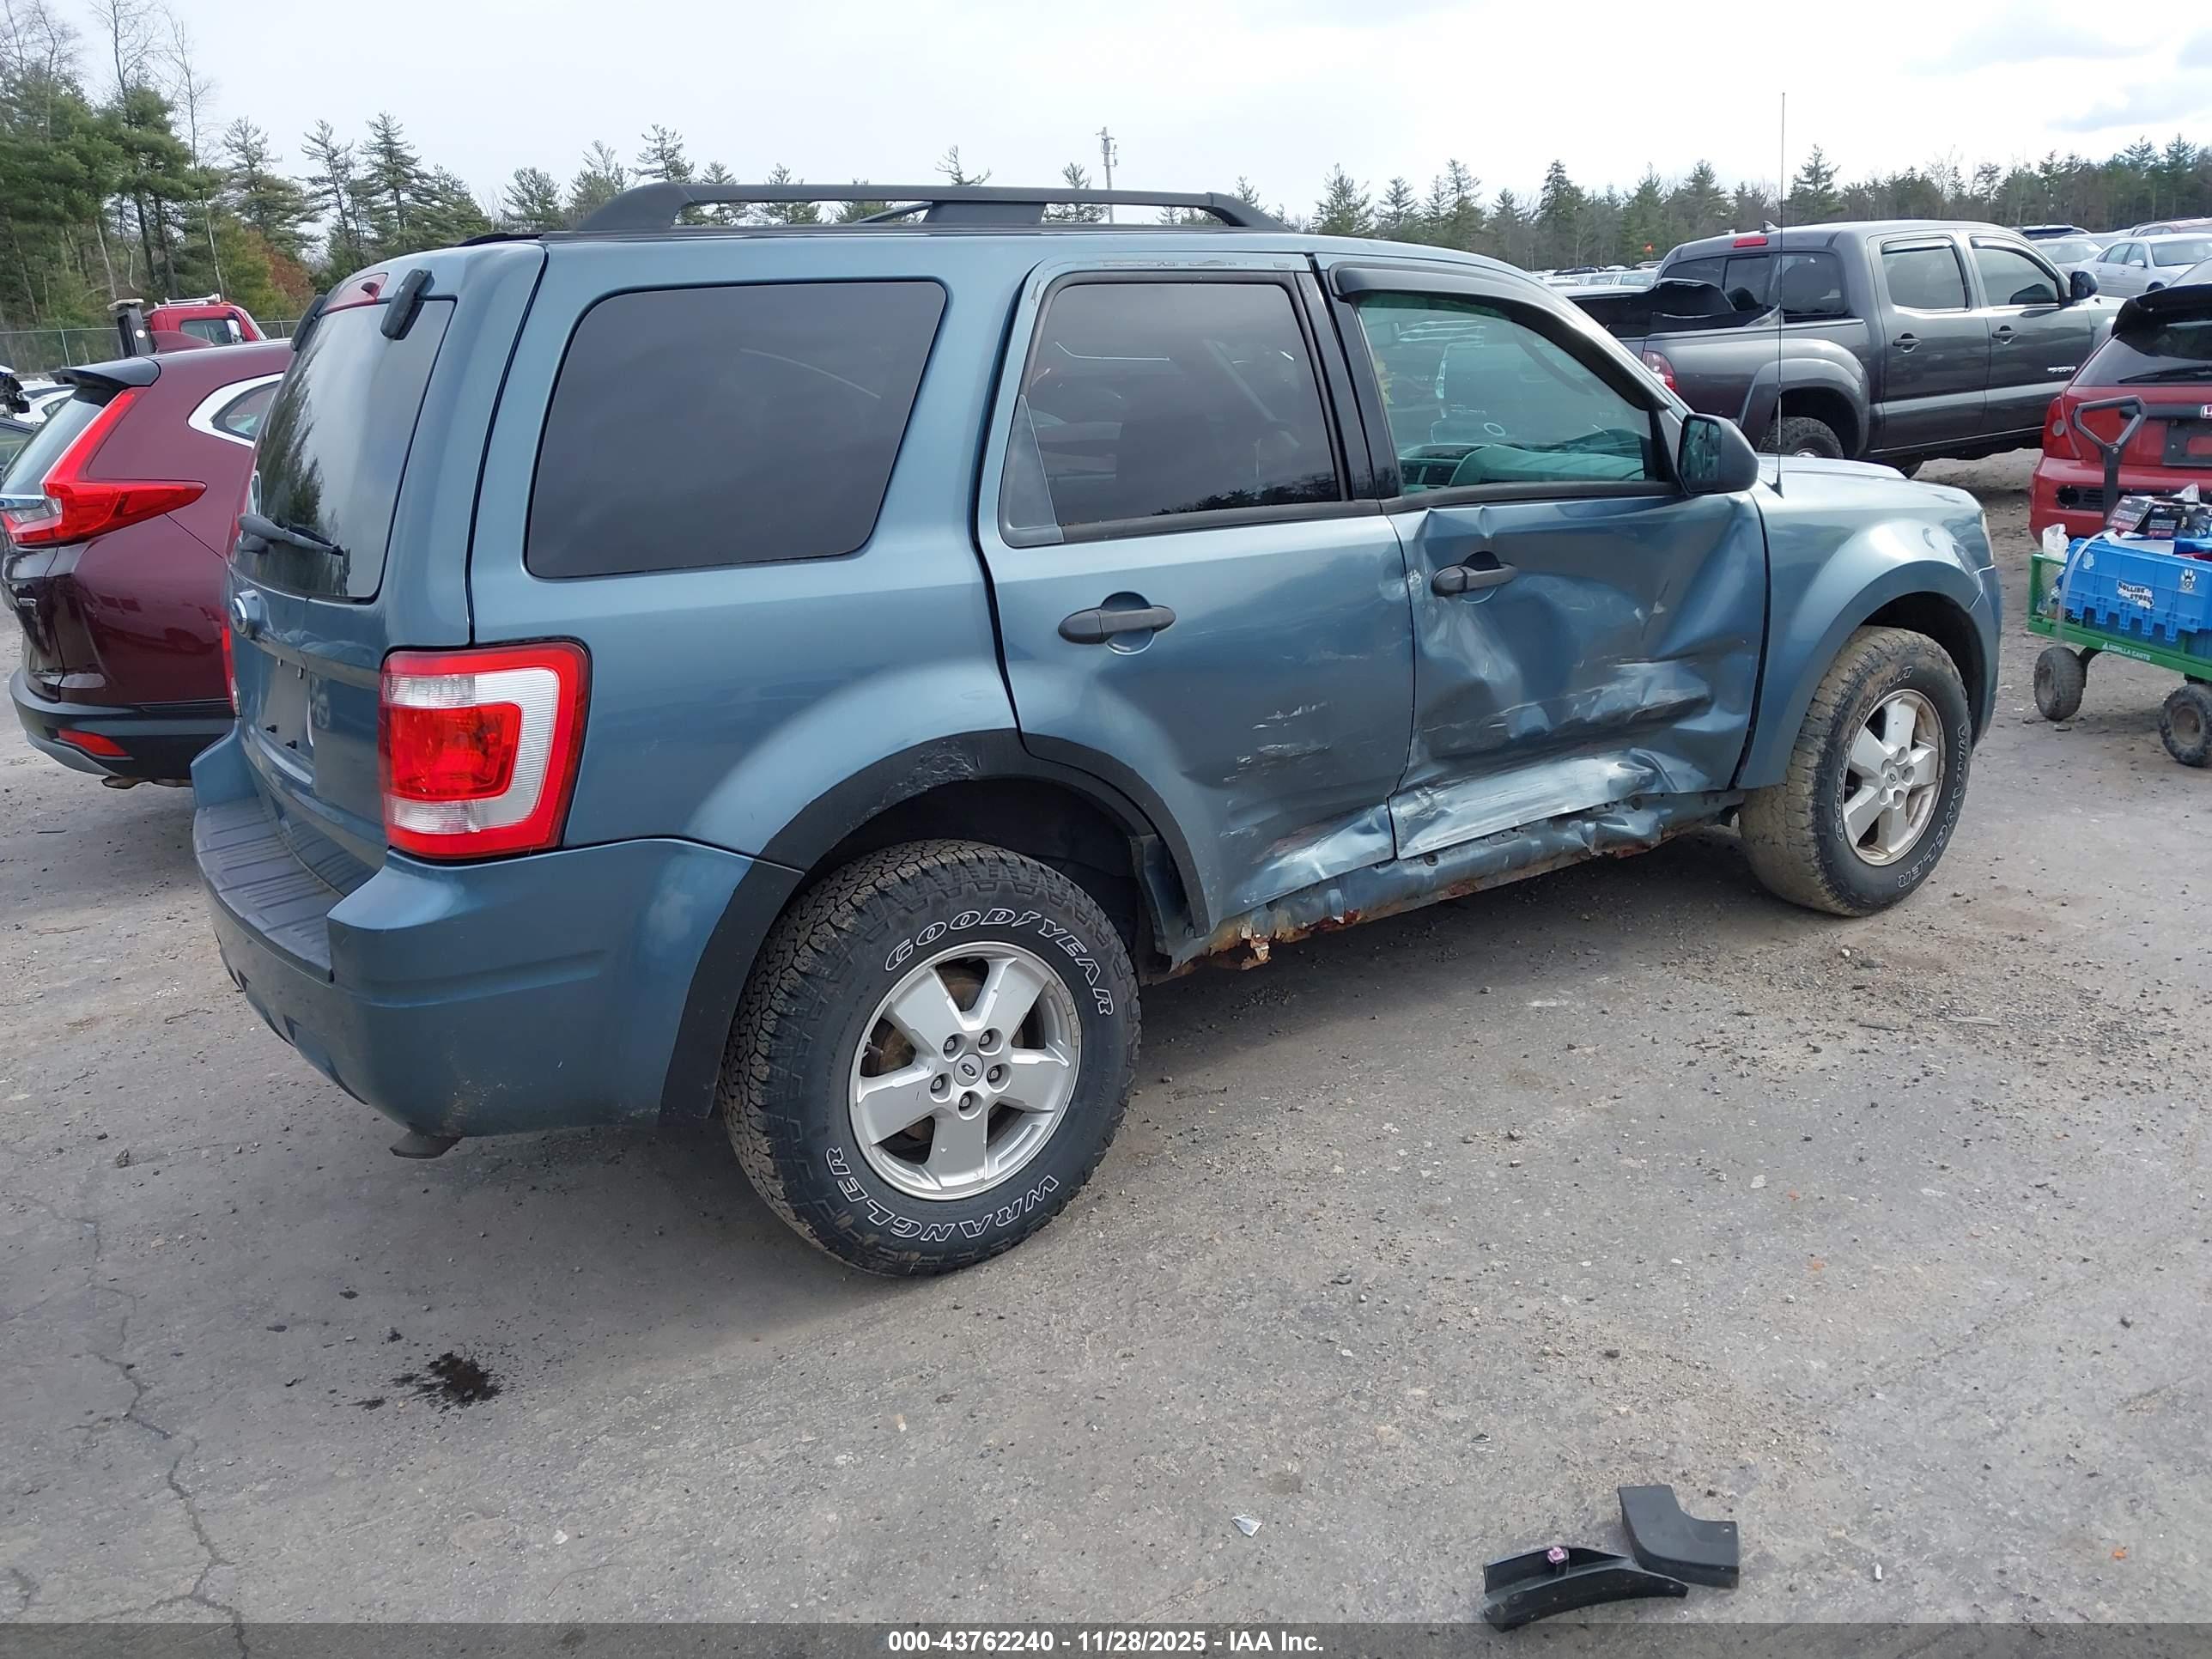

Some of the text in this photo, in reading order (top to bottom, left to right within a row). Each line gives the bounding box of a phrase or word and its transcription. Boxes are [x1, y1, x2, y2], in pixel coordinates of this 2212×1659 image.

[1898, 723, 1966, 889] WRANGLER
[885, 908, 1114, 1016] GOODYEAR
[825, 1146, 1060, 1242] WRANGLER
